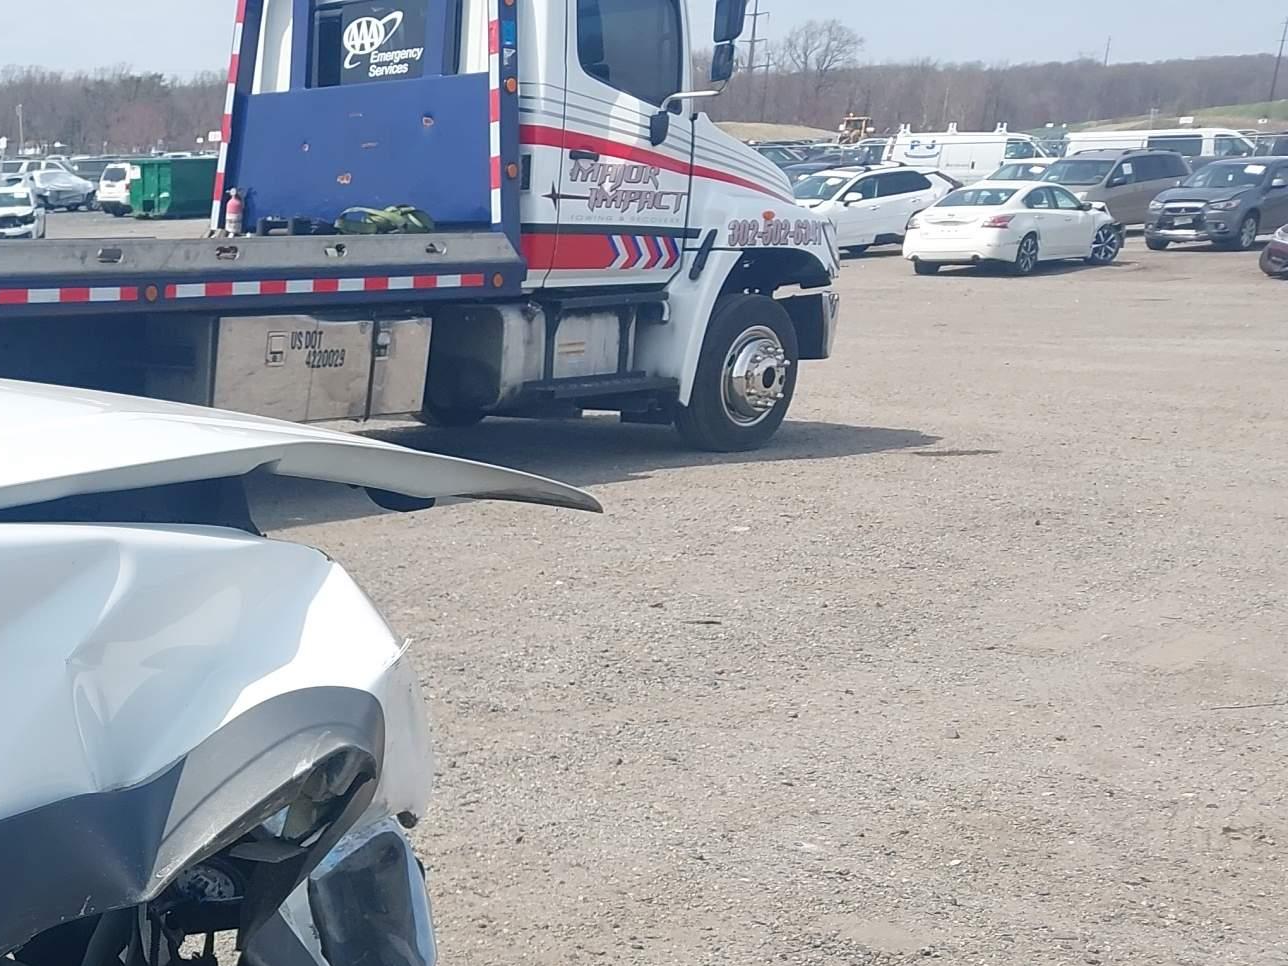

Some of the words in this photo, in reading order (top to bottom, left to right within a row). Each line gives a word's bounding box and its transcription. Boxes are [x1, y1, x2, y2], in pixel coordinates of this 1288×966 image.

[348, 19, 381, 51] AAA
[370, 47, 423, 63] Emergency
[368, 62, 408, 77] Services
[569, 160, 660, 192] MAJOR
[587, 188, 688, 214] IMPACT
[570, 214, 613, 222] TOWING
[291, 331, 304, 350] US
[305, 331, 323, 349] DOT
